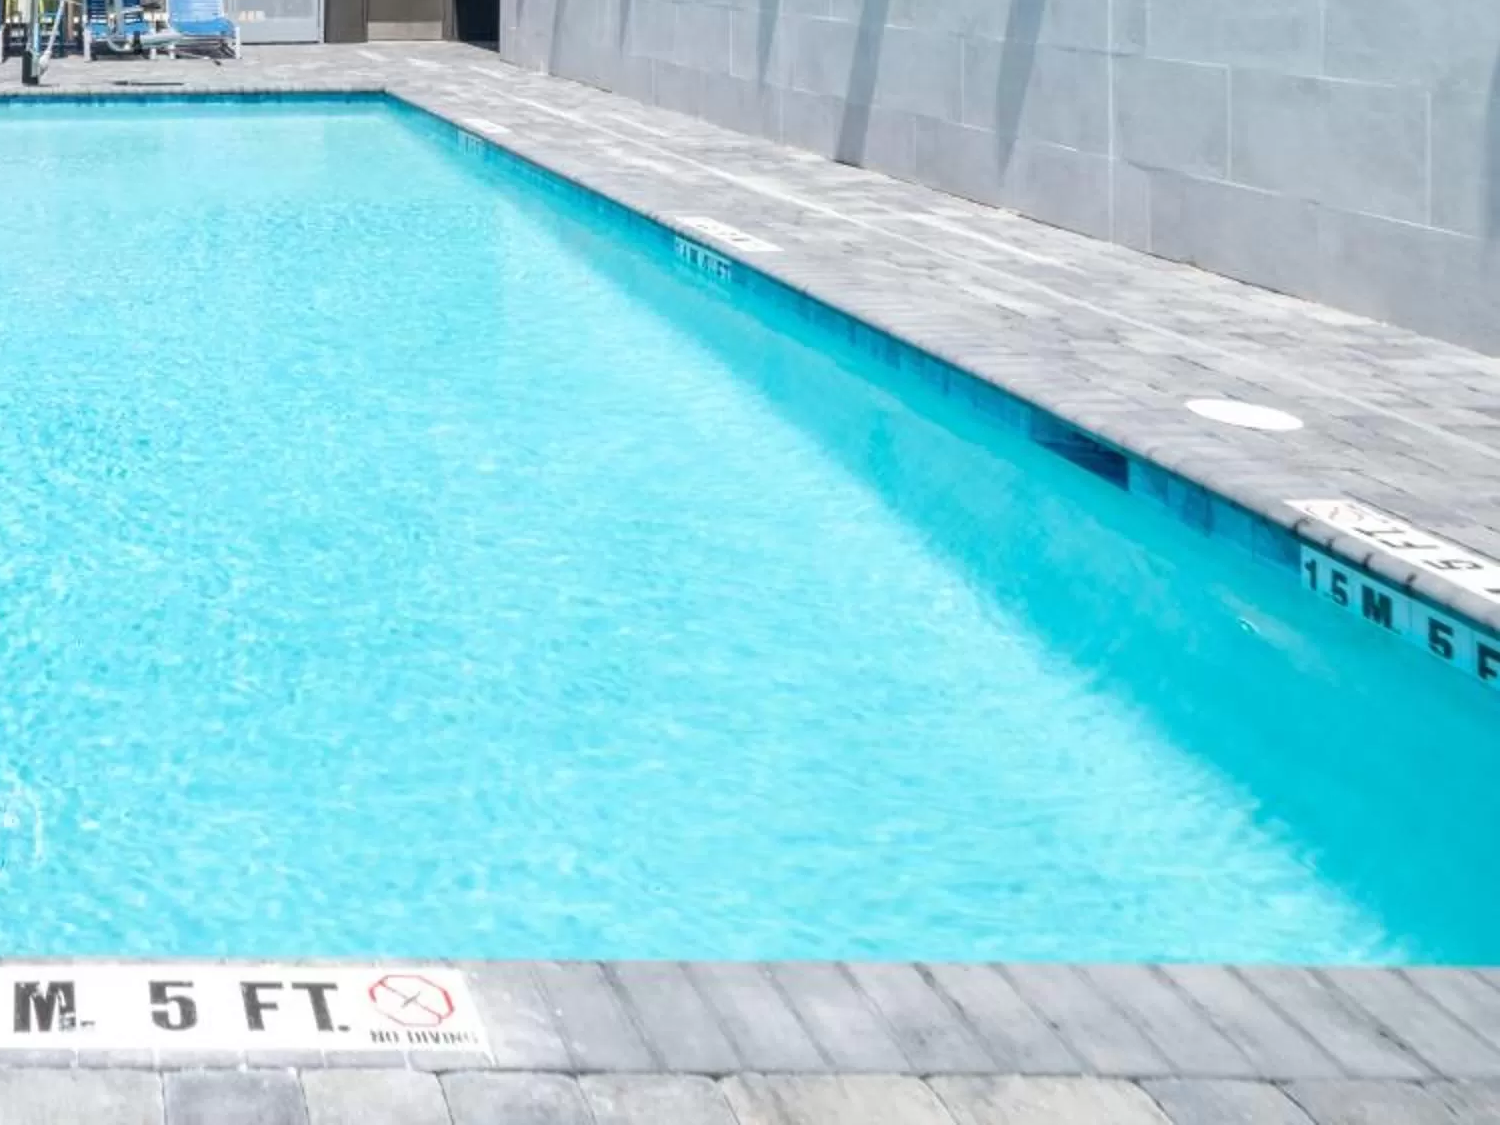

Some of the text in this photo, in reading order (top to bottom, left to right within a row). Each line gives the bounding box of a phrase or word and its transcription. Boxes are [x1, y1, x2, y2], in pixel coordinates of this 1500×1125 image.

[1427, 616, 1454, 661] 5
[148, 980, 197, 1031] 5
[239, 981, 350, 1032] FT.
[370, 1030, 479, 1044] NO DIVING
